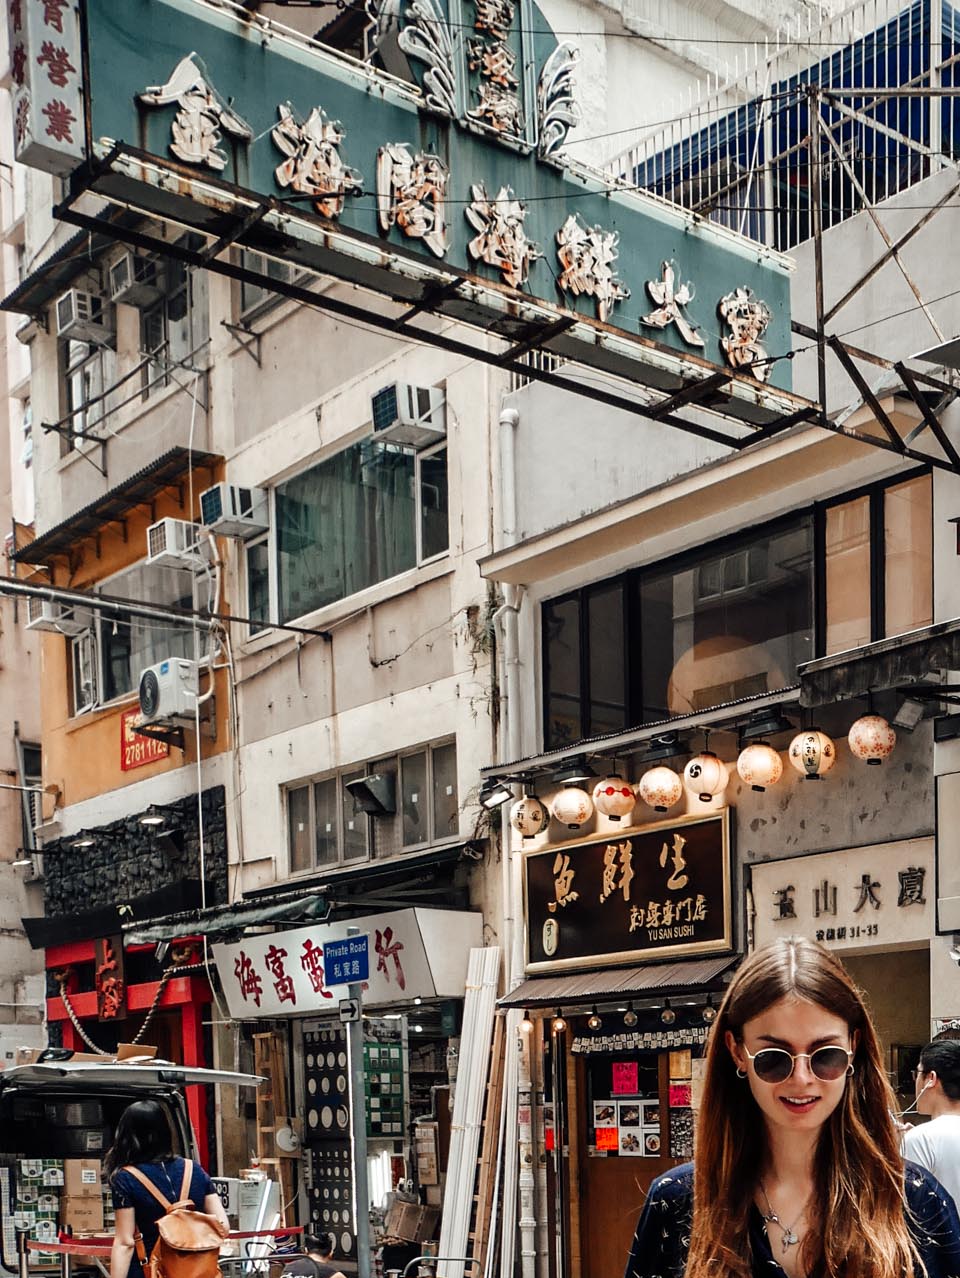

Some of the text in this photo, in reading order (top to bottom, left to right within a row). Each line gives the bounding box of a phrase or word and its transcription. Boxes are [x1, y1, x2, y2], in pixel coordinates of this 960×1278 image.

[125, 741, 145, 765] 2781
[548, 833, 690, 913] 魚鮮生
[772, 866, 927, 921] 玉山大廈
[648, 924, 695, 941] YU SAN SUSHI
[326, 940, 367, 958] Private Road
[333, 960, 360, 978] 私家路
